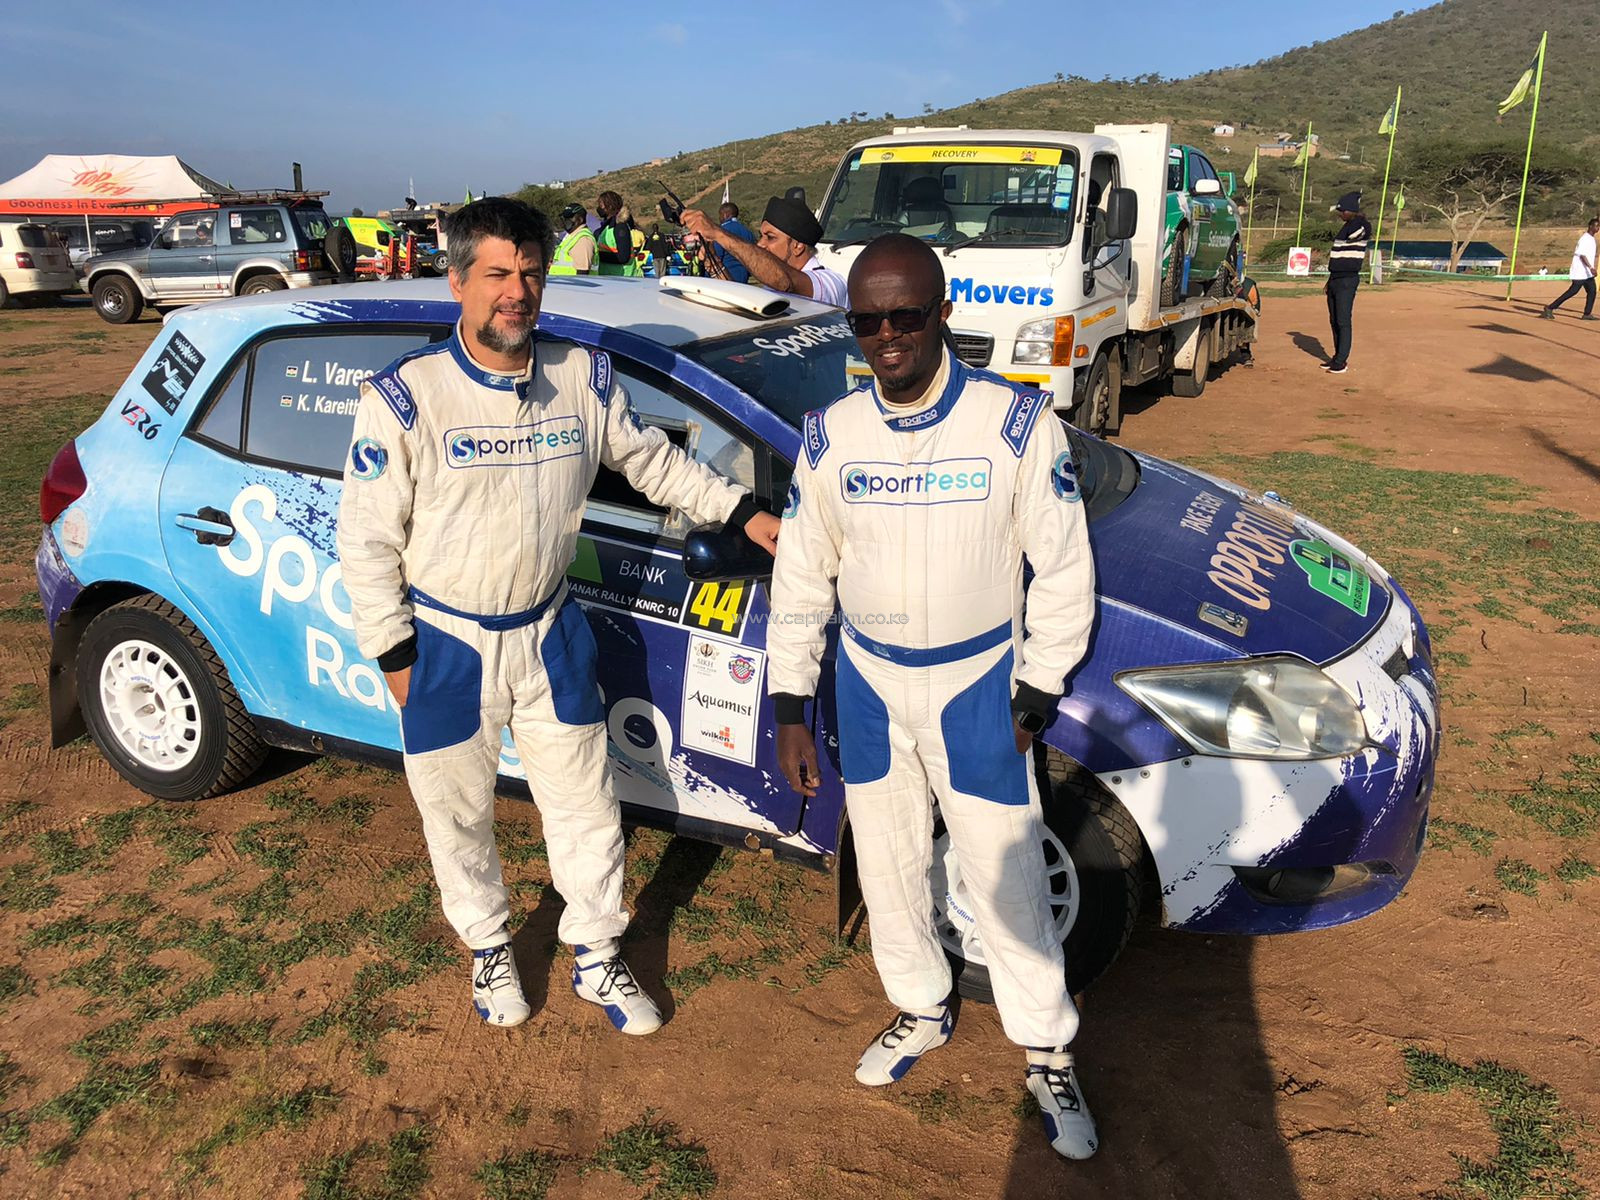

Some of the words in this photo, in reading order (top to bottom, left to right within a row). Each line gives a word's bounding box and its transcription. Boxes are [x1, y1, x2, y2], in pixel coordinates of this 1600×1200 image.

[931, 150, 978, 158] RECOVERY
[9, 200, 72, 209] Goodness
[951, 278, 1053, 306] Movers
[302, 360, 317, 383] L.
[297, 394, 310, 412] K.
[897, 408, 938, 428] sparco
[1010, 397, 1035, 439] sparco
[619, 560, 667, 585] BANK
[601, 590, 635, 606] RALLY
[635, 598, 665, 614] KNRC
[667, 606, 679, 618] 10
[690, 579, 745, 633] 44
[688, 690, 752, 716] Aquamist
[701, 730, 730, 743] wilken
